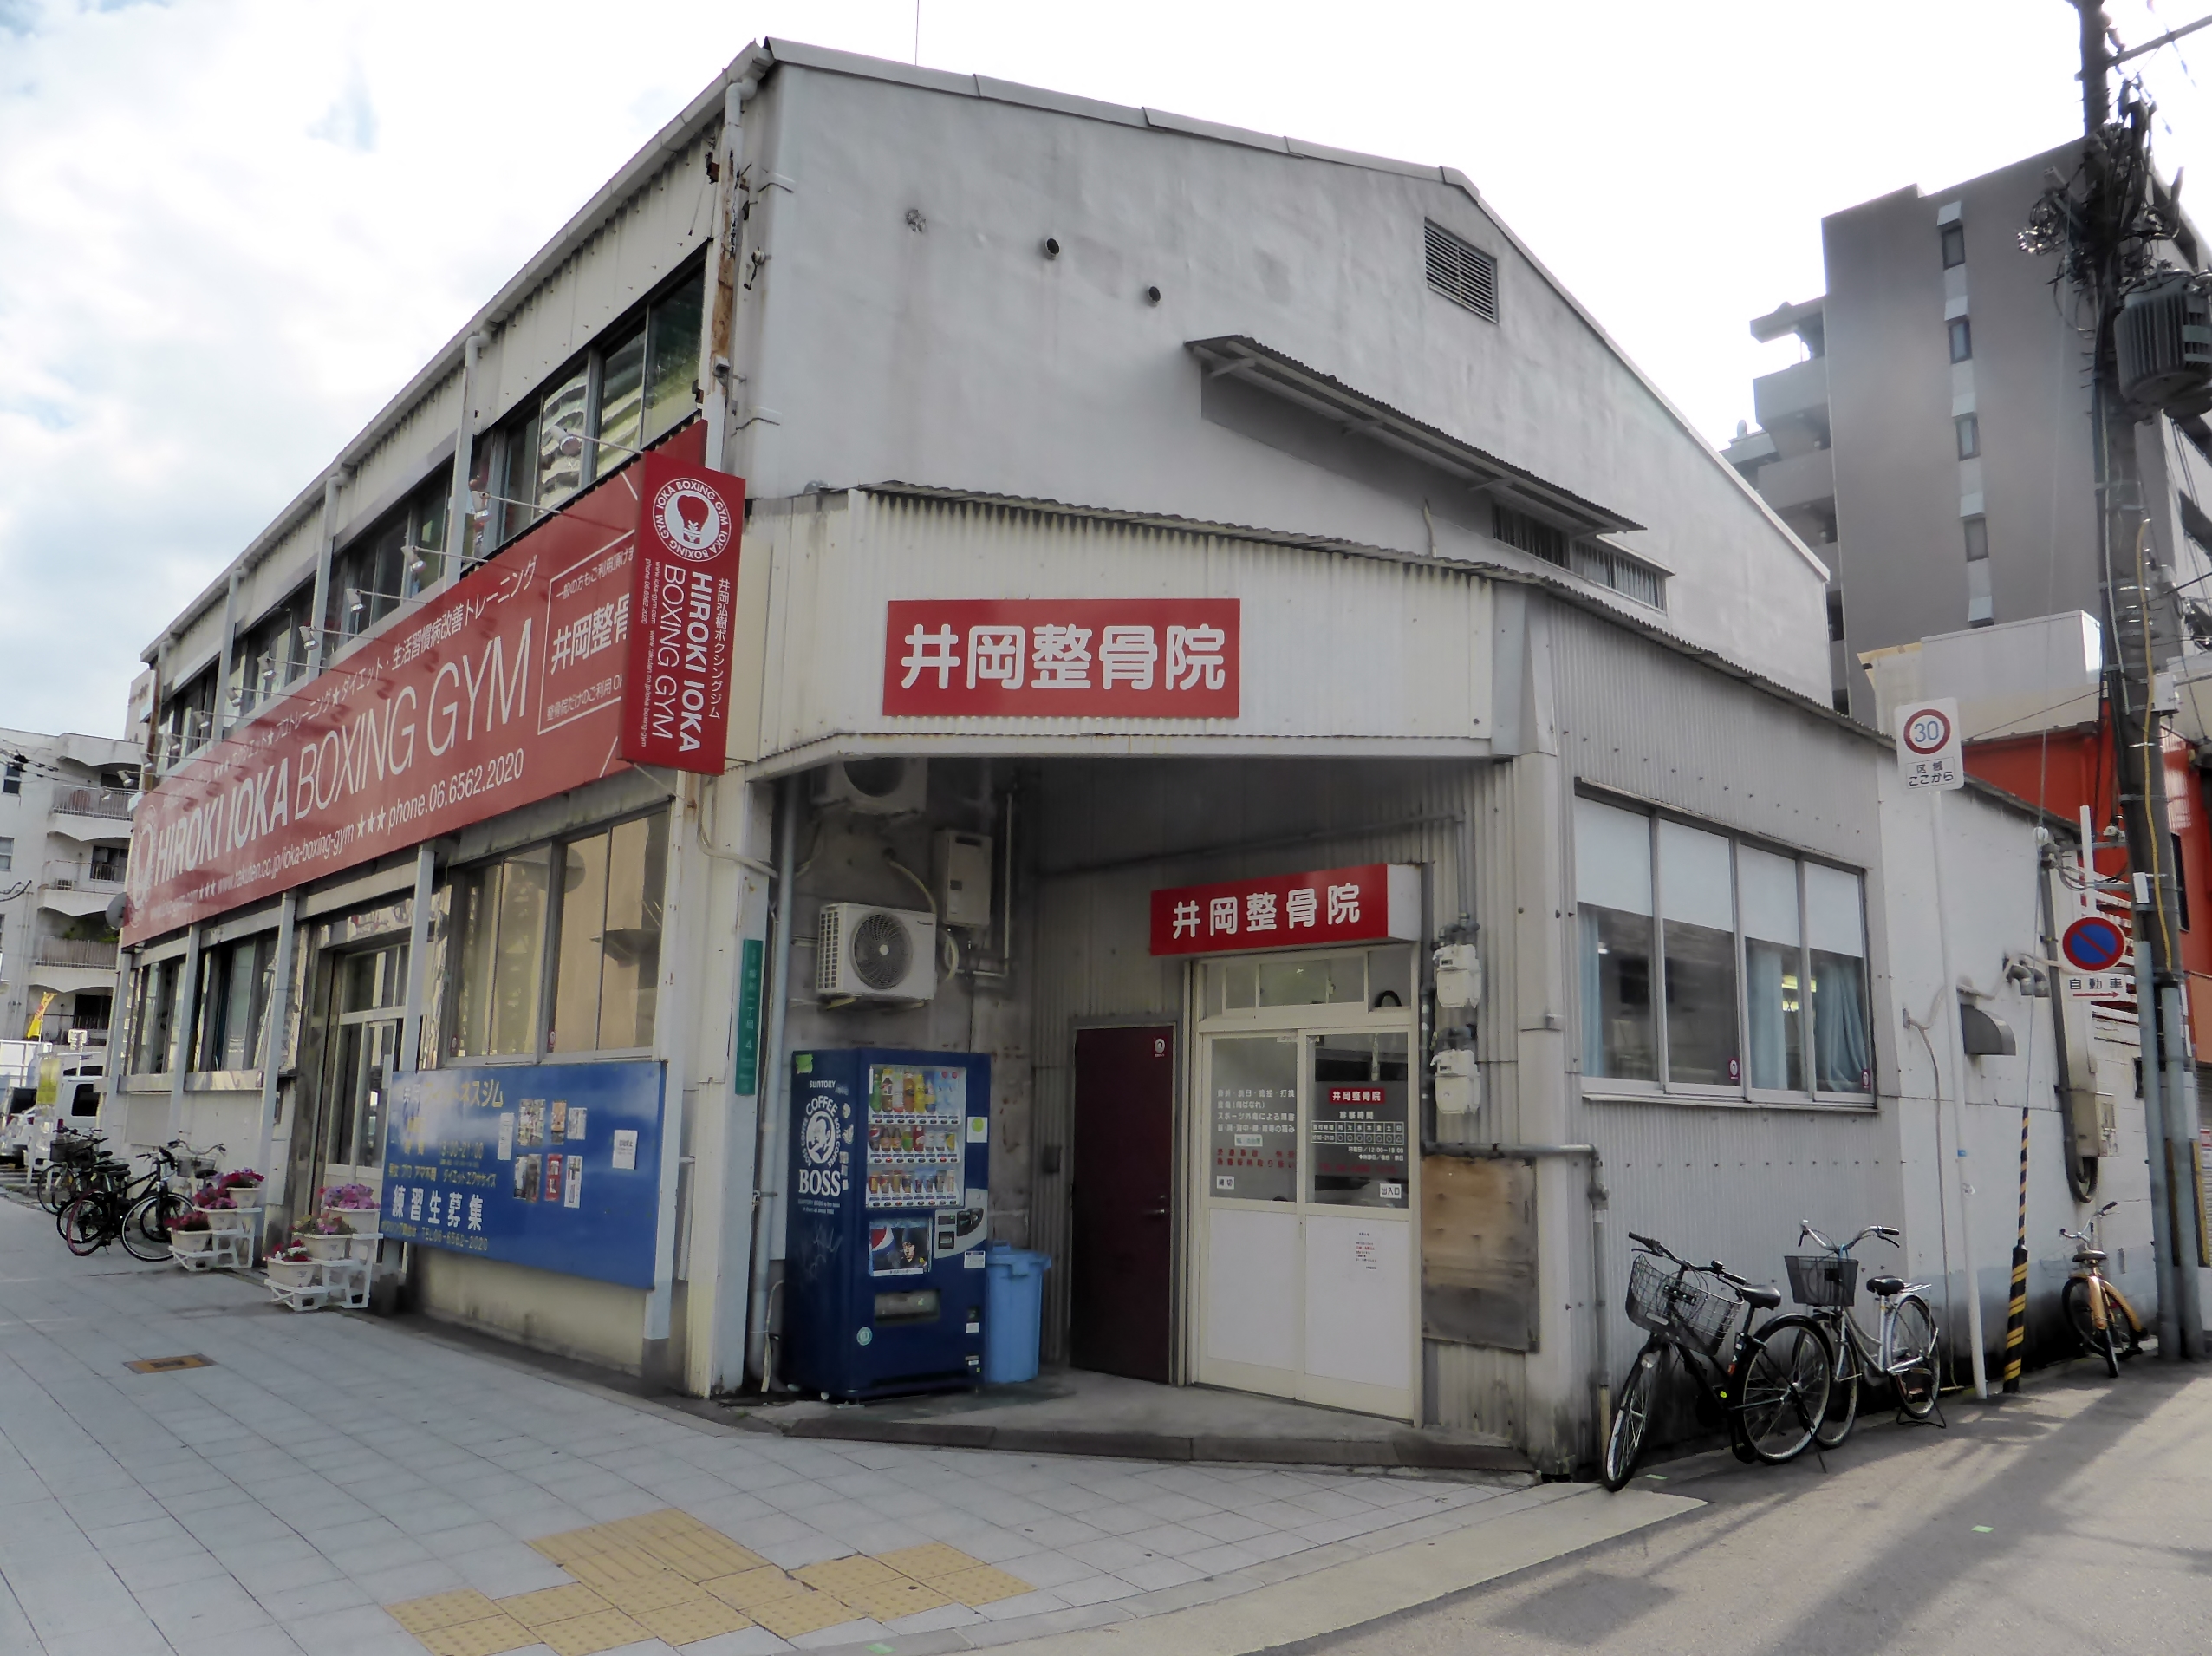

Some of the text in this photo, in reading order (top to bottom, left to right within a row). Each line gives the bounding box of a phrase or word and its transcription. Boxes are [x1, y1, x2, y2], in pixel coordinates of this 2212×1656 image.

[655, 480, 729, 559] IOKA BOXING GYM IOKA BOXING GYM
[651, 564, 686, 740] BOXING GYM
[679, 571, 713, 753] HIROKI IOKA
[708, 577, 731, 720] 井岡弘樹ボクシングジム
[900, 623, 1226, 691] 井岡整骨院
[154, 793, 224, 886] HIROKI
[225, 757, 288, 852] IOKA
[295, 685, 417, 821] BOXING
[426, 617, 532, 757] GYM
[1914, 720, 1939, 743] 30
[387, 747, 524, 835] phone.06.6562.2020
[1909, 771, 1955, 787] ここから
[1916, 761, 1943, 775] 区域
[1172, 883, 1361, 940] 井岡整骨院
[2068, 977, 2124, 991] 自動車
[805, 1095, 838, 1117] COFFEE
[391, 1183, 484, 1231] 練習生募集
[798, 1168, 841, 1197] BOSS
[1381, 1186, 1401, 1196] 出入口
